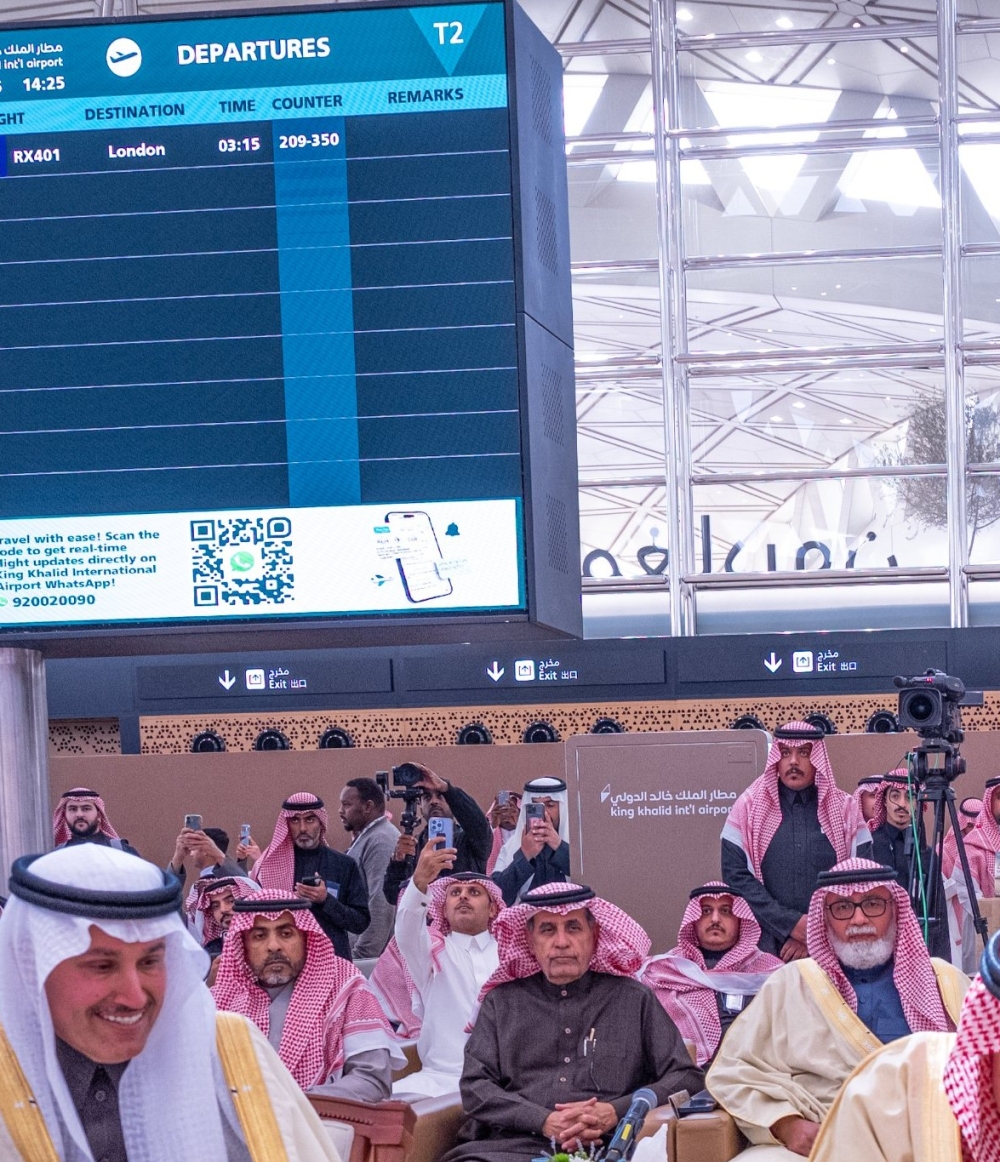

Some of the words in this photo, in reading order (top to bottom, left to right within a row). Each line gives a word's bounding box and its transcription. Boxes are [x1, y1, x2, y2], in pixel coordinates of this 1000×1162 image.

[433, 21, 464, 45] T2
[4, 43, 34, 55] الملك
[36, 43, 63, 55] مطار
[177, 36, 331, 65] DEPARTURES
[4, 58, 24, 69] int'l
[27, 57, 63, 70] airport
[23, 76, 65, 91] 14:25
[0, 112, 25, 125] GHT
[84, 103, 185, 121] DESTINATION
[219, 100, 256, 114] TIME
[272, 94, 343, 110] COUNTER
[388, 88, 464, 104] REMARKS
[13, 148, 61, 163] RX401
[108, 142, 166, 158] London
[218, 137, 261, 153] 03:15
[279, 132, 340, 149] 209-350
[0, 535, 30, 545] ravel
[34, 534, 63, 544] with
[67, 532, 101, 542] ease!
[105, 531, 135, 541] Scan
[138, 530, 160, 540] the
[0, 547, 23, 556] ode
[27, 547, 41, 556] to
[44, 546, 66, 557] get
[69, 543, 127, 554] real-time
[0, 557, 30, 569] light
[33, 556, 84, 568] updates
[88, 554, 136, 565] directly
[140, 554, 157, 562] on
[28, 568, 69, 578] Khalid
[72, 565, 157, 577] International
[45, 578, 116, 590] WhatsApp!
[13, 594, 96, 607] 920020090
[817, 650, 839, 662] مخرج
[539, 659, 560, 671] مخرج
[817, 662, 836, 672] Exit
[269, 667, 290, 679] مخرج
[539, 670, 558, 680] Exit
[269, 679, 287, 689] Exit
[610, 791, 647, 806] الدولي
[649, 791, 673, 801] خالد
[675, 790, 707, 801] الملك
[709, 790, 737, 802] مطار
[610, 806, 635, 819] king
[638, 805, 672, 816] khalid
[675, 804, 695, 815] int'l
[698, 804, 733, 817] airpor
